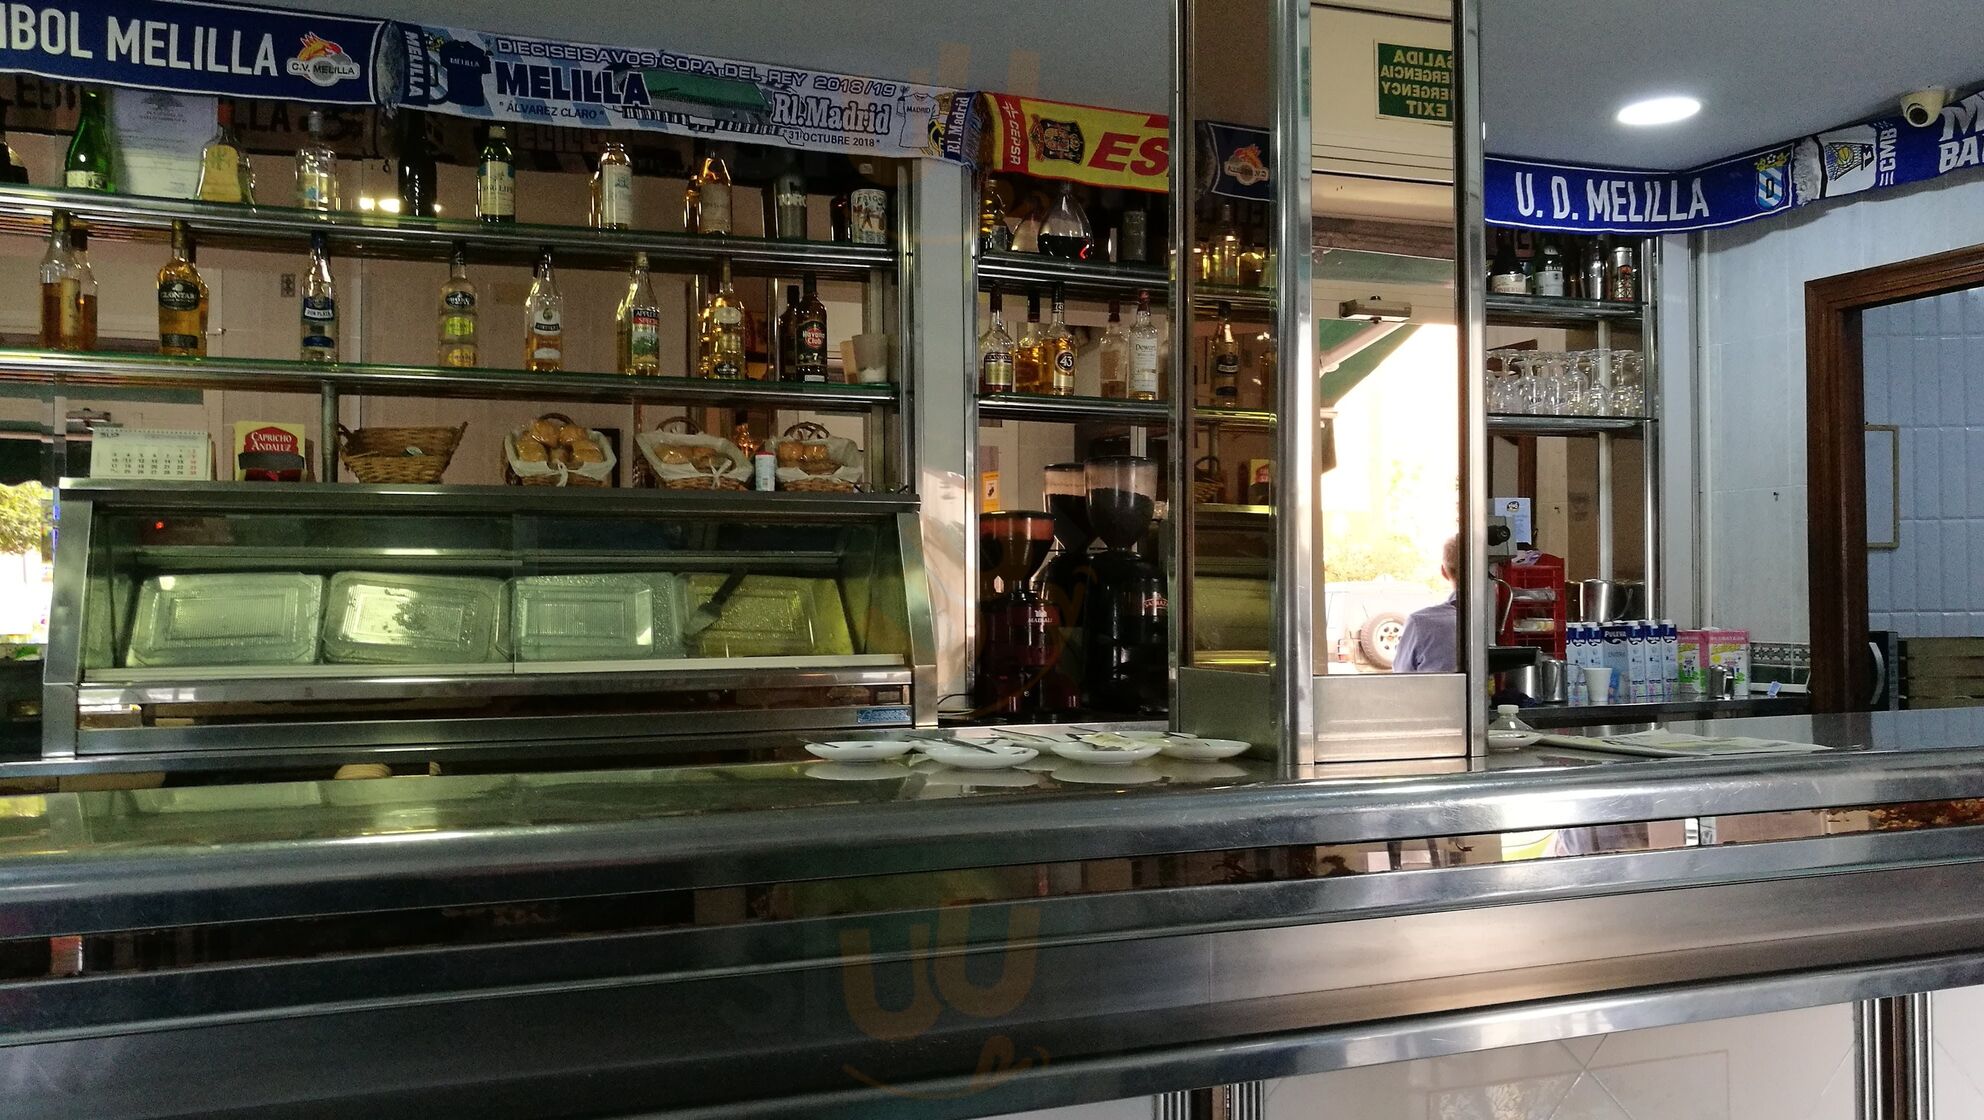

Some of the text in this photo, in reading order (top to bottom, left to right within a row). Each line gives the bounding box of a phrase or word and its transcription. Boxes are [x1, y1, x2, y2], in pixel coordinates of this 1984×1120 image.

[107, 16, 278, 77] MELILLA
[313, 64, 356, 76] MELILLA
[404, 31, 425, 98] MELILLA
[496, 38, 897, 97] DIECISEISAVOS COPA DEL REY 2018/19
[494, 60, 651, 107] MELILLA
[560, 105, 598, 120] CLARO
[906, 105, 931, 114] MADRID
[802, 132, 850, 145] OCTUBRE
[1010, 113, 1021, 165] CEPSA
[1087, 131, 1169, 177] ES
[1938, 133, 1984, 174] BA
[1515, 171, 1711, 222] U. D. MELILLA
[1059, 355, 1072, 367] 43
[251, 431, 292, 443] CAPRICHO
[251, 440, 292, 452] ANDALUZ
[1604, 630, 1627, 638] PULEVA
